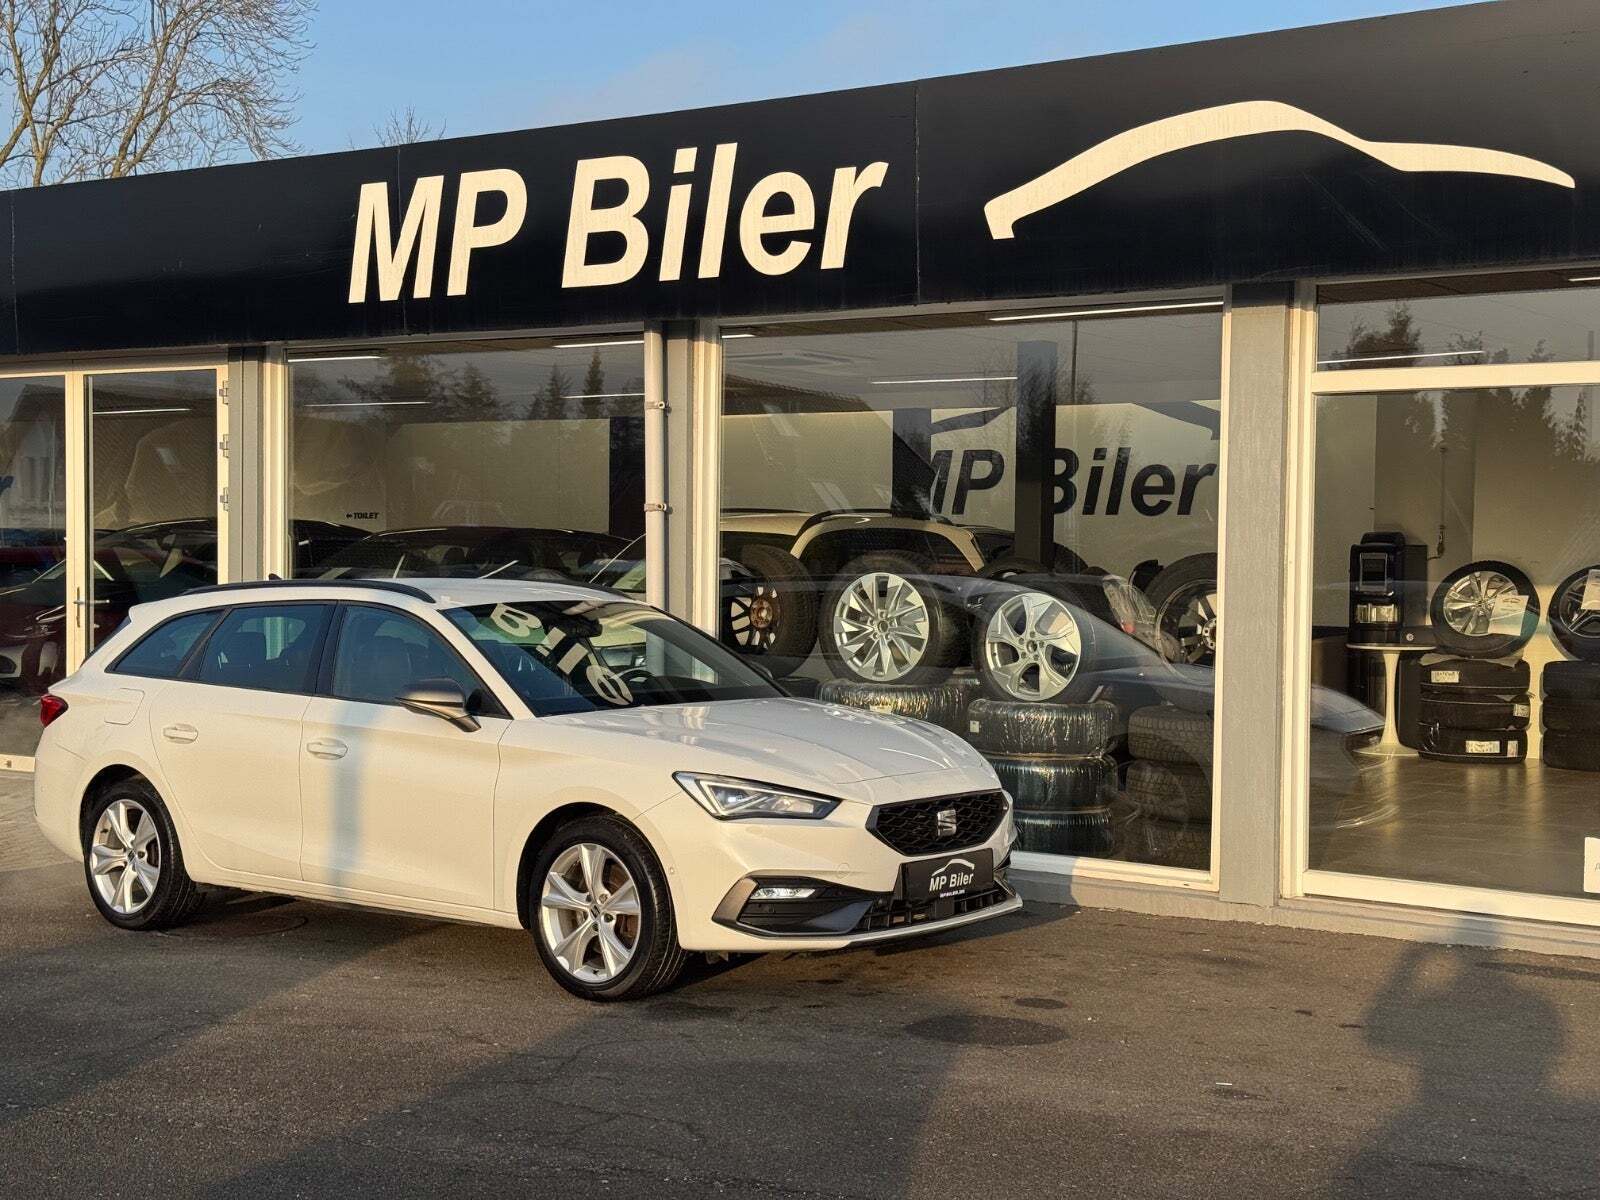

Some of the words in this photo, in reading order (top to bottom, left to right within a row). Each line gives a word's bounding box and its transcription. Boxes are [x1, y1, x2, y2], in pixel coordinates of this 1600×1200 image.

[349, 169, 527, 304] MP
[562, 142, 888, 288] Biler
[929, 875, 947, 891] MP
[949, 872, 974, 887] Biler
